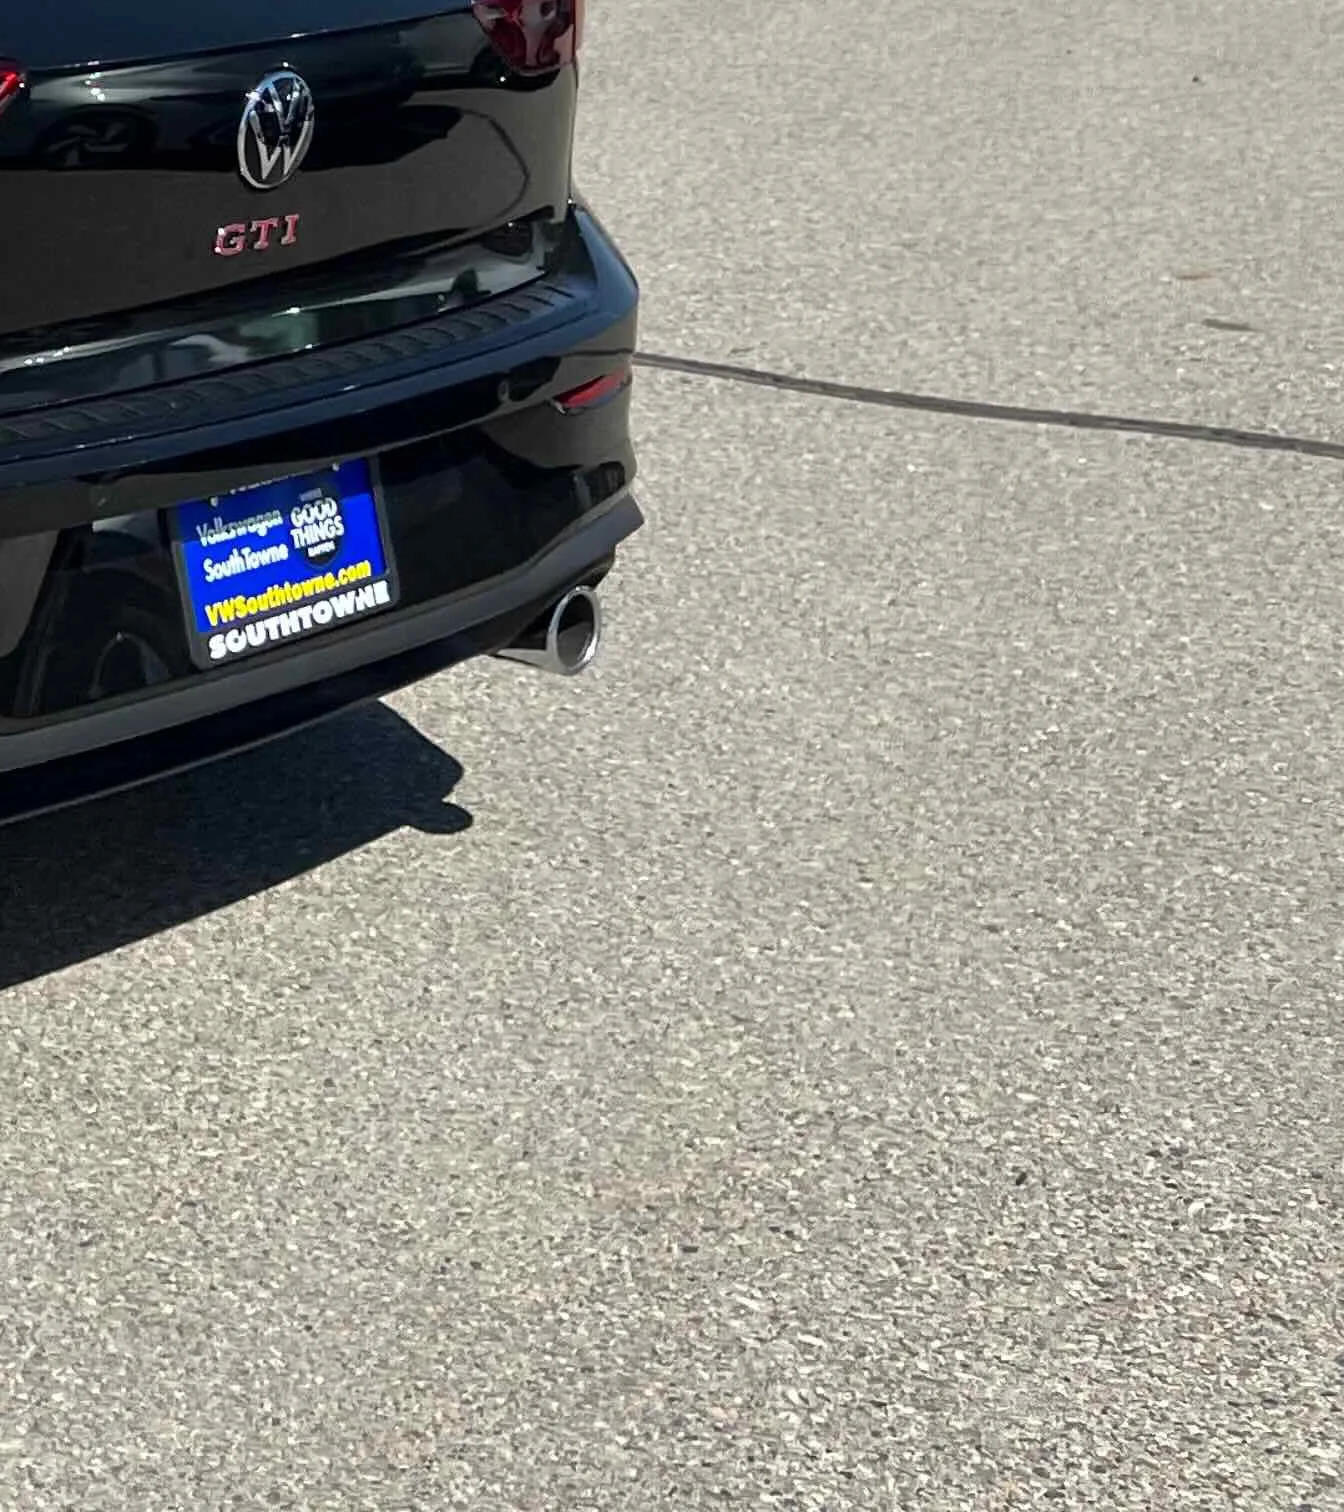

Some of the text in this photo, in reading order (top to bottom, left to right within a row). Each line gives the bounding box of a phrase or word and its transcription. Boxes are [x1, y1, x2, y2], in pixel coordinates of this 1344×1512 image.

[214, 213, 300, 257] GTI
[195, 509, 284, 547] Volkswagen
[290, 497, 338, 528] GOOD
[290, 515, 345, 550] THINGS
[204, 559, 372, 627] VWSouthtowne.com
[208, 579, 392, 660] SOUTHTOWNE
